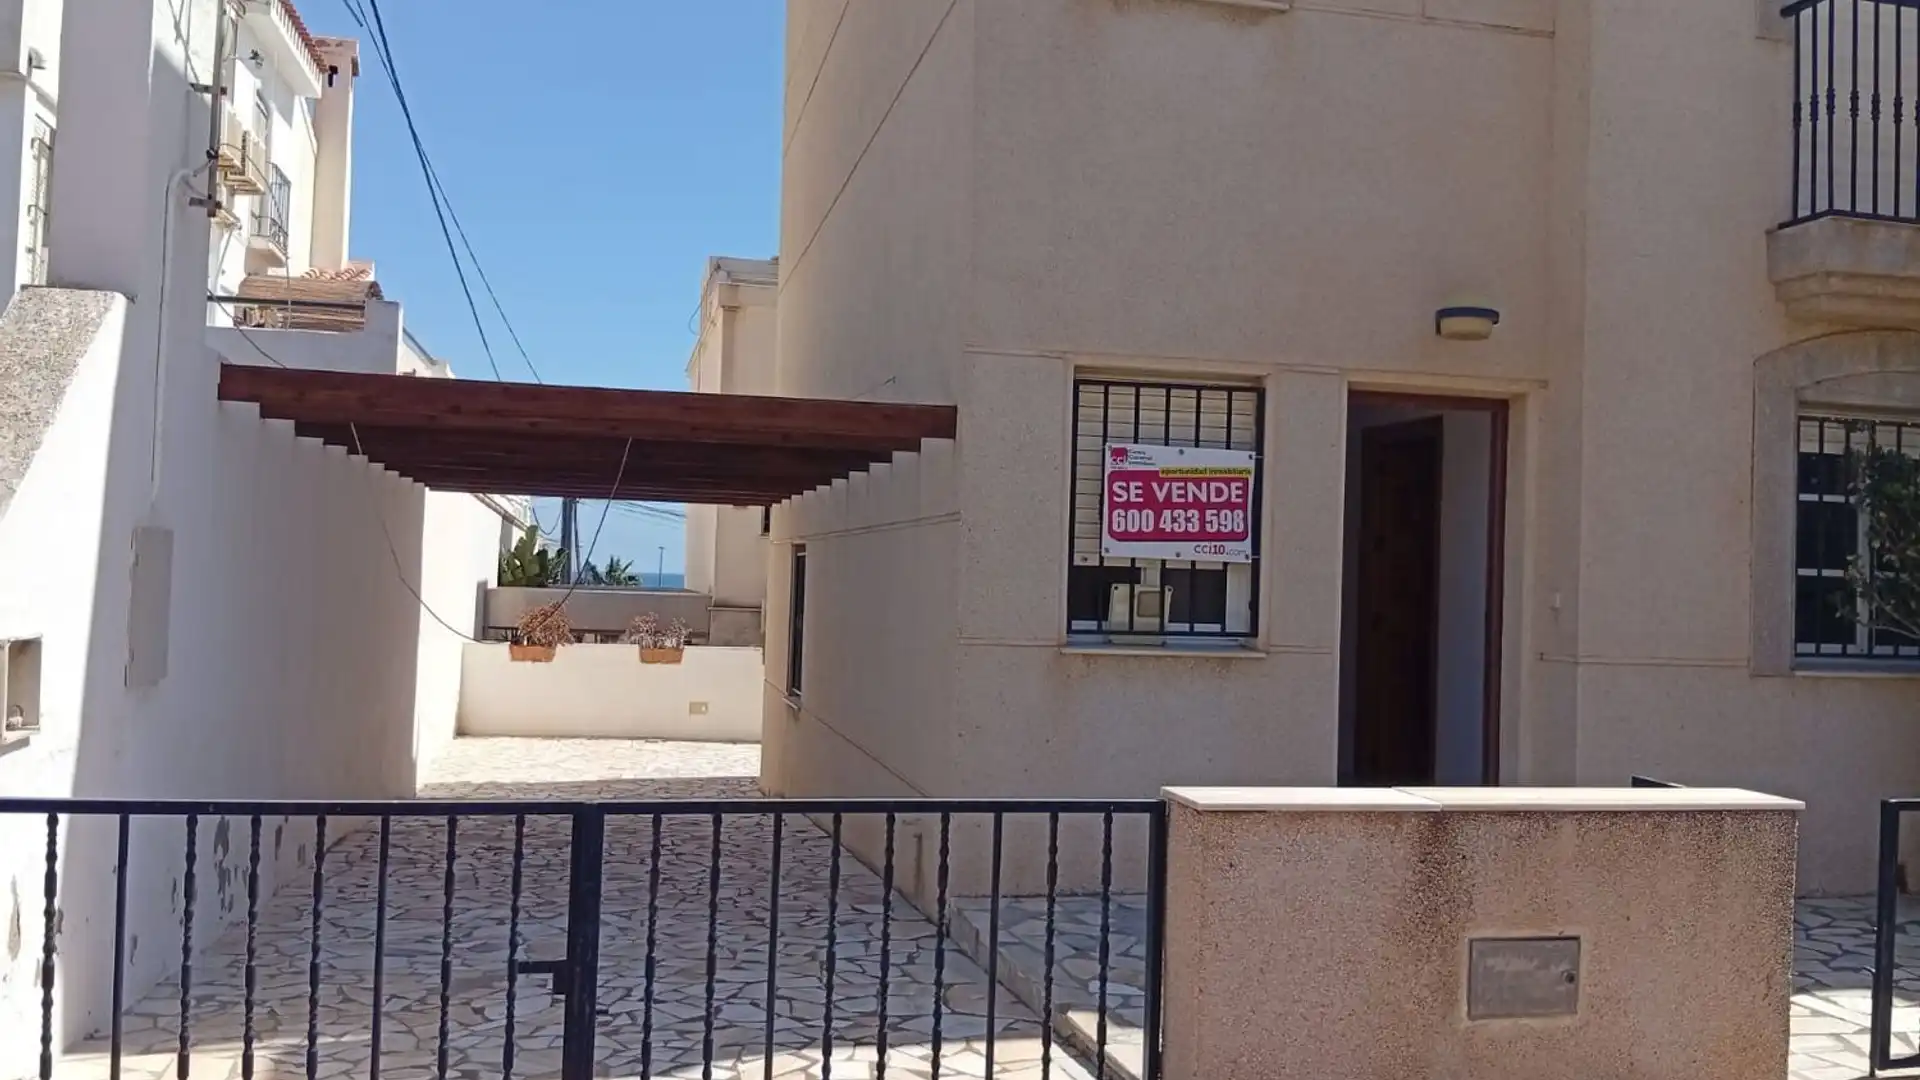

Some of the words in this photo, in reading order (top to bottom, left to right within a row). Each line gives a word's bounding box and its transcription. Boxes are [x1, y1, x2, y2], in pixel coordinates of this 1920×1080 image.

[1112, 481, 1144, 503] SE
[1150, 482, 1244, 503] VENDE
[1112, 509, 1155, 532] 600
[1159, 509, 1200, 533] 433
[1205, 509, 1244, 533] 598
